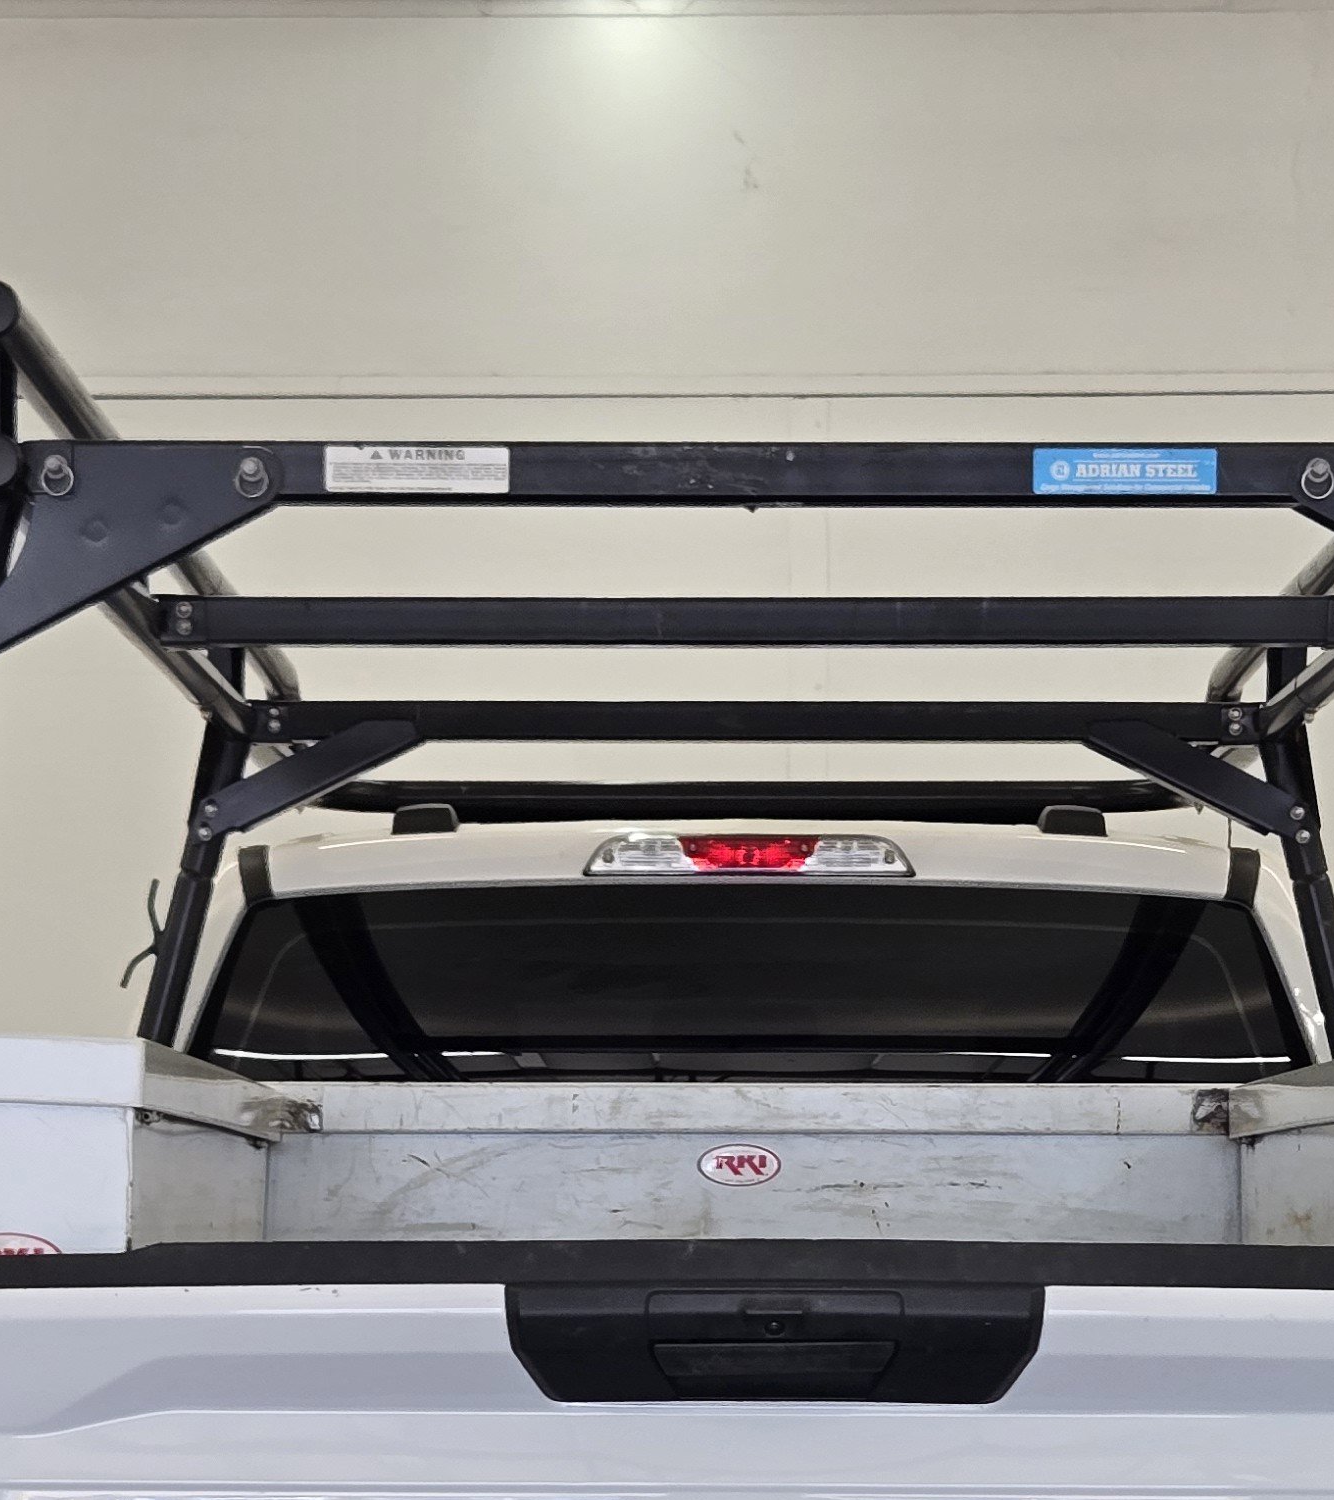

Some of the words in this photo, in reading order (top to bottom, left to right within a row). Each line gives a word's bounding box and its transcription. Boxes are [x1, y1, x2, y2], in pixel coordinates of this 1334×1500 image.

[388, 449, 466, 461] WARNING
[1075, 464, 1141, 478] ADRIAN
[1145, 464, 1198, 478] STEEL
[713, 1154, 767, 1176] RKI
